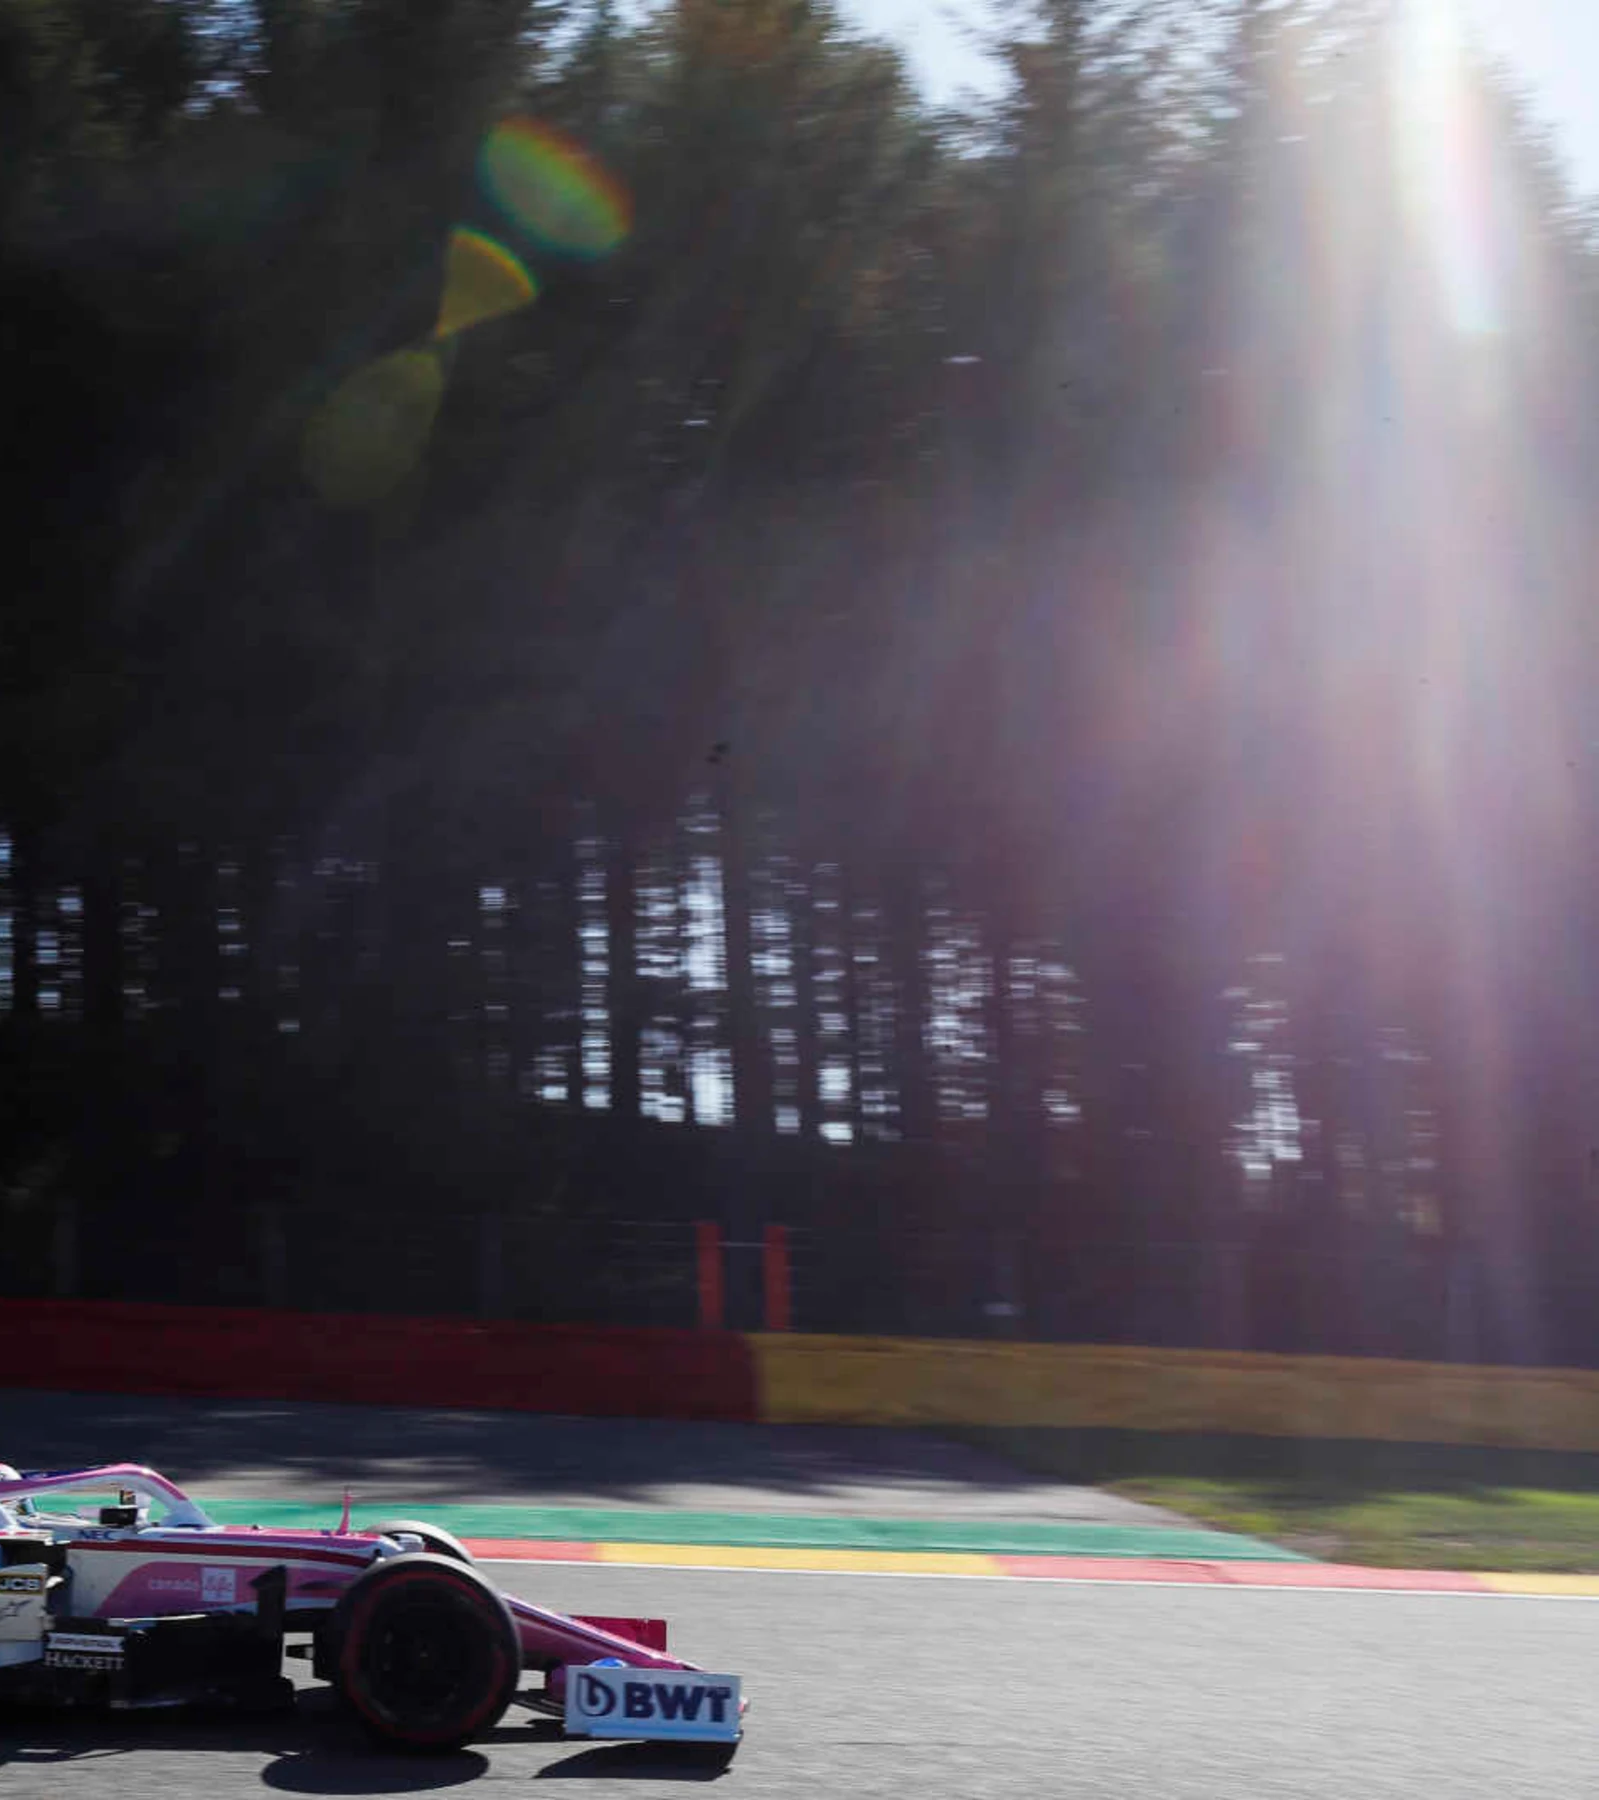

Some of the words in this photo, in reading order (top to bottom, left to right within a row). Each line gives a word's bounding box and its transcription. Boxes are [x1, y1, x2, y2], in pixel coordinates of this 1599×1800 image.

[78, 1529, 113, 1541] NEC
[44, 1651, 125, 1670] HACKETT
[623, 1680, 732, 1724] BWT
